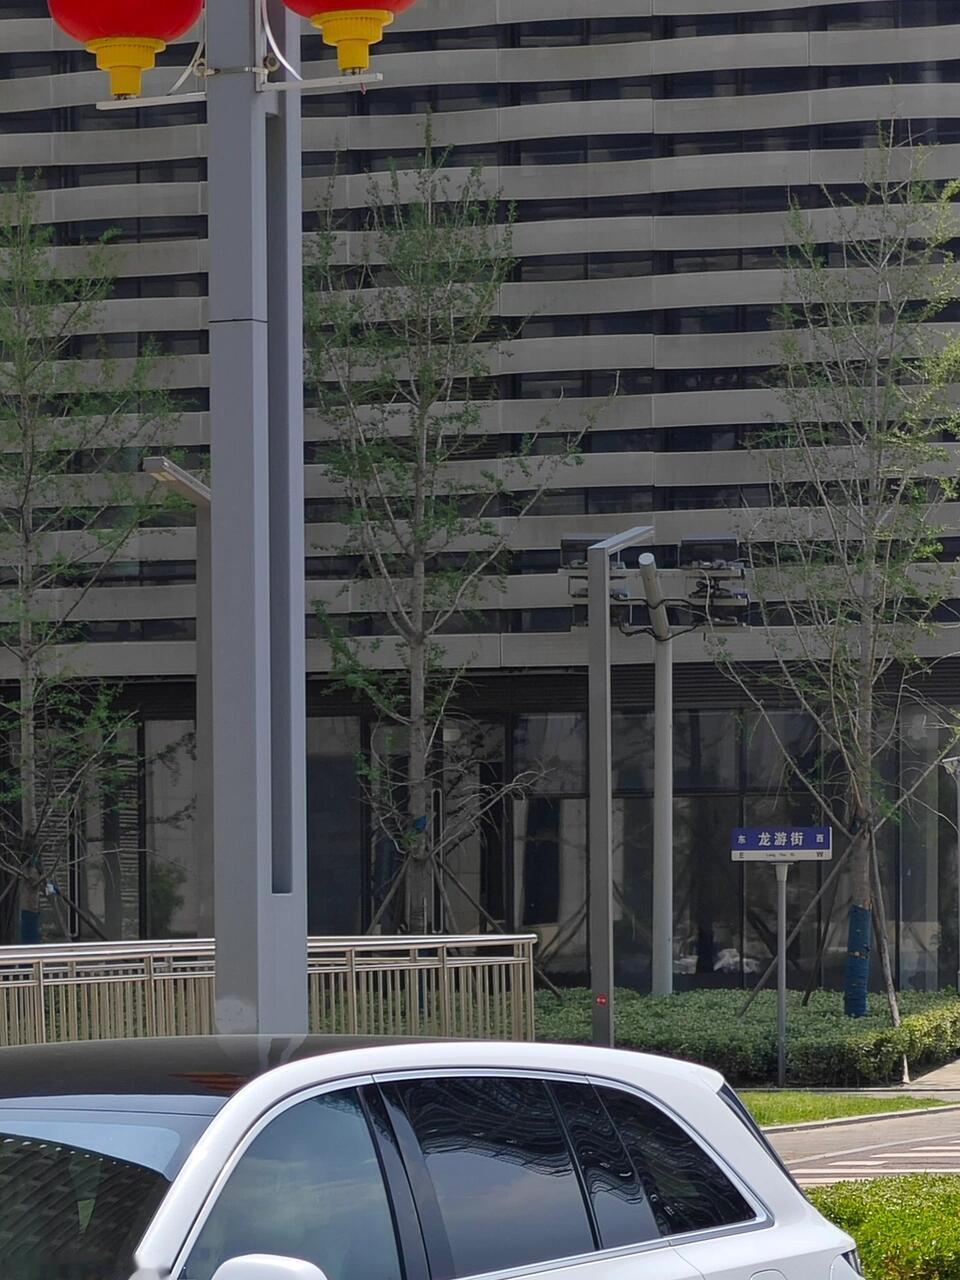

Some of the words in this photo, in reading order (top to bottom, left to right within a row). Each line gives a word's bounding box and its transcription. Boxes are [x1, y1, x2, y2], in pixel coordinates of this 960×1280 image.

[737, 835, 746, 844] 东
[758, 831, 804, 847] 龙游街
[816, 834, 824, 843] 西
